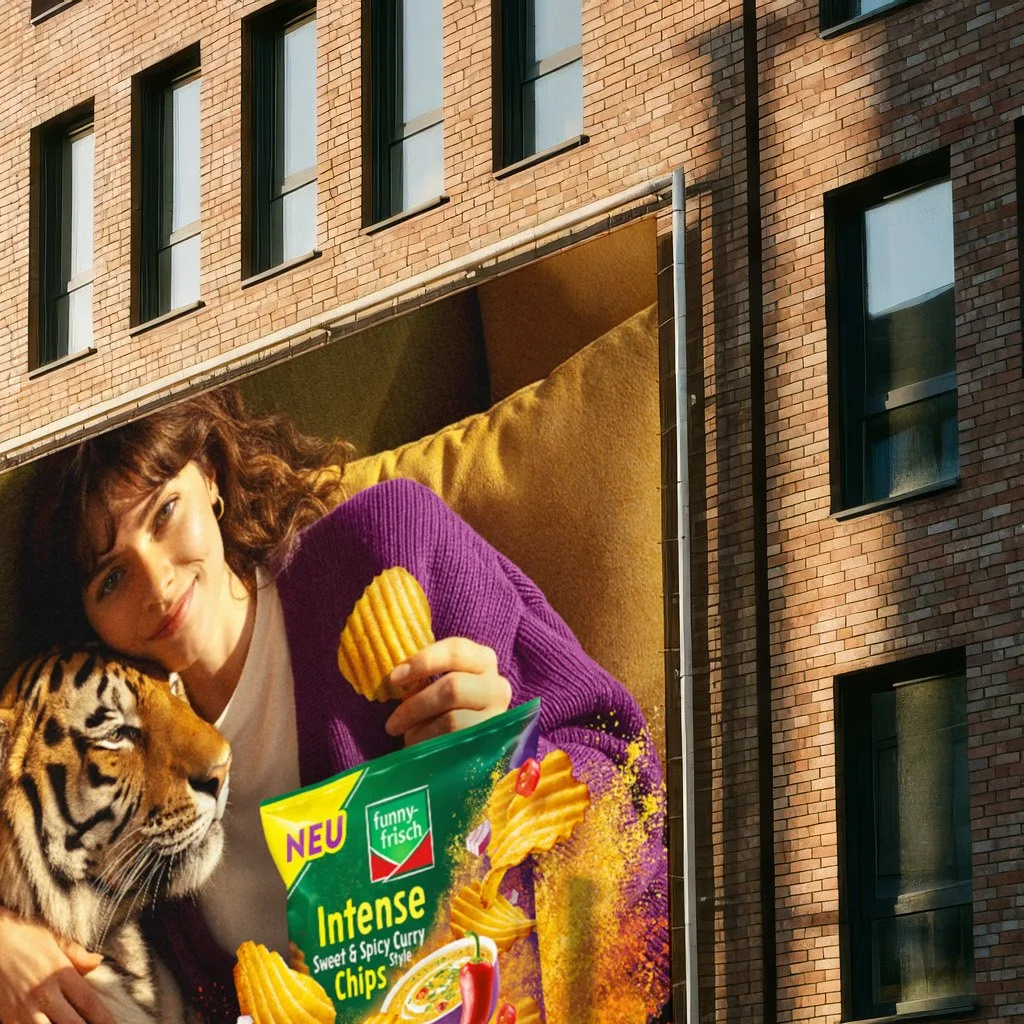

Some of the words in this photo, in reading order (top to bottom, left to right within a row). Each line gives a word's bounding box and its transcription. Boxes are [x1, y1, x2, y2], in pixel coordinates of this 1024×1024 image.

[373, 805, 419, 831] funny-
[380, 820, 423, 849] frisch
[286, 815, 343, 863] NEU
[317, 885, 426, 947] Intense
[312, 948, 346, 974] Sweet
[349, 943, 357, 963] &
[359, 938, 391, 963] Spicy
[393, 928, 425, 950] Curry
[389, 949, 413, 968] Style
[335, 965, 387, 1001] Chips
